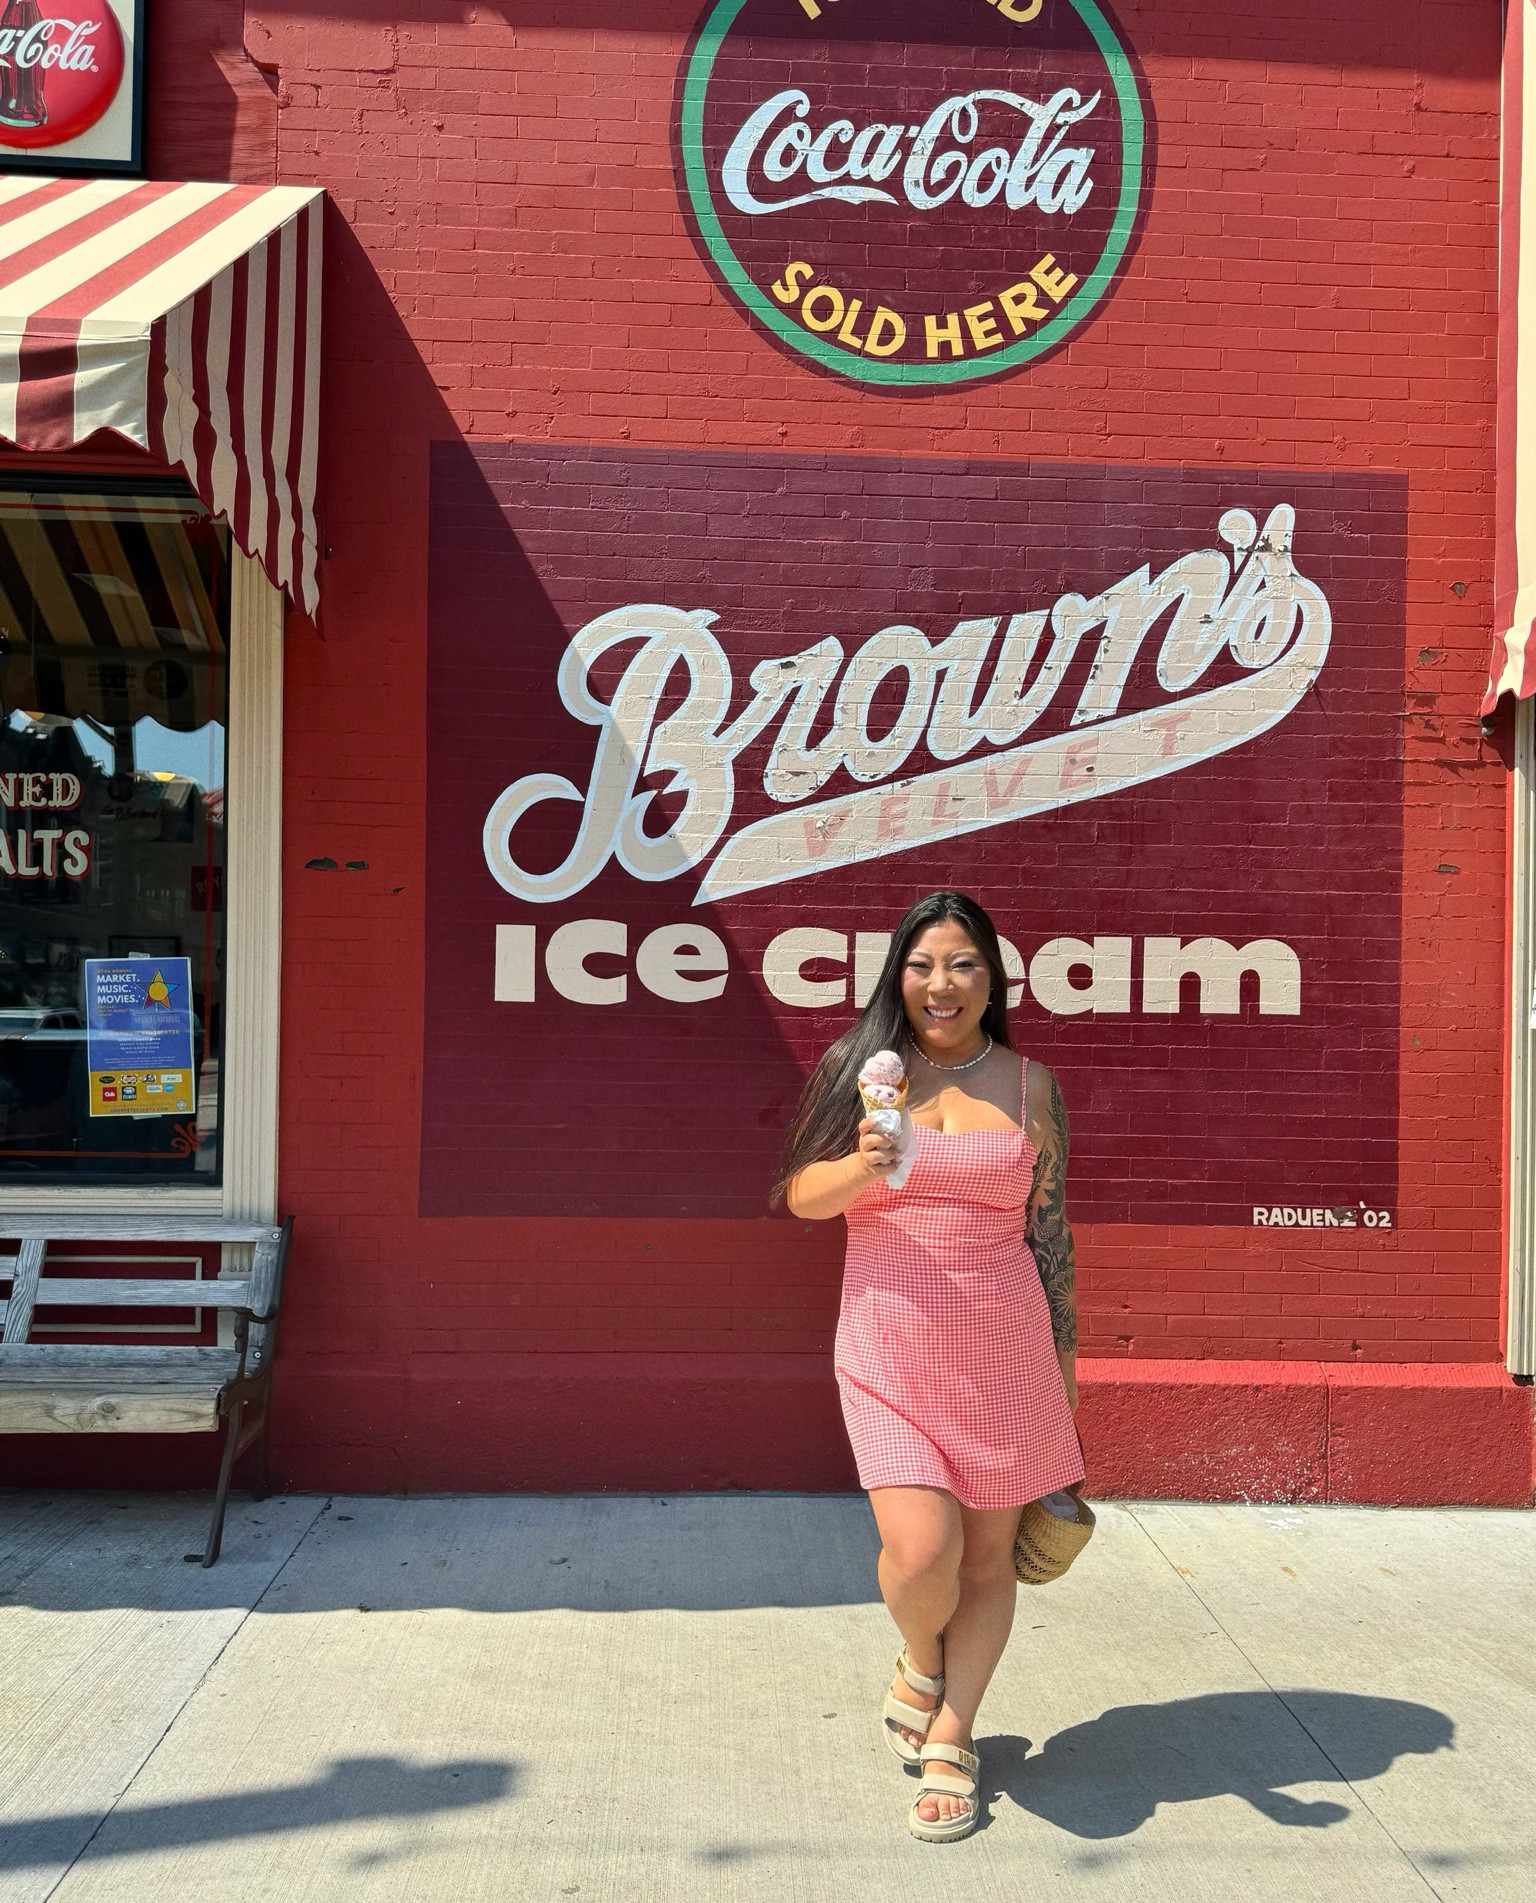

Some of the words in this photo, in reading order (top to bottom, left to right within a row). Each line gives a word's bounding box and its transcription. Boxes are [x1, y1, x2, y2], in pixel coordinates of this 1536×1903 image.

[722, 87, 1102, 214] Coca-Cola
[771, 261, 906, 357] SOLD
[925, 253, 1079, 358] HERE
[483, 503, 1332, 905] Brown's
[802, 711, 1191, 858] VELVET
[96, 973, 140, 983] MARKET.
[97, 984, 132, 994] MUSIC.
[97, 995, 139, 1005] MOVIES.
